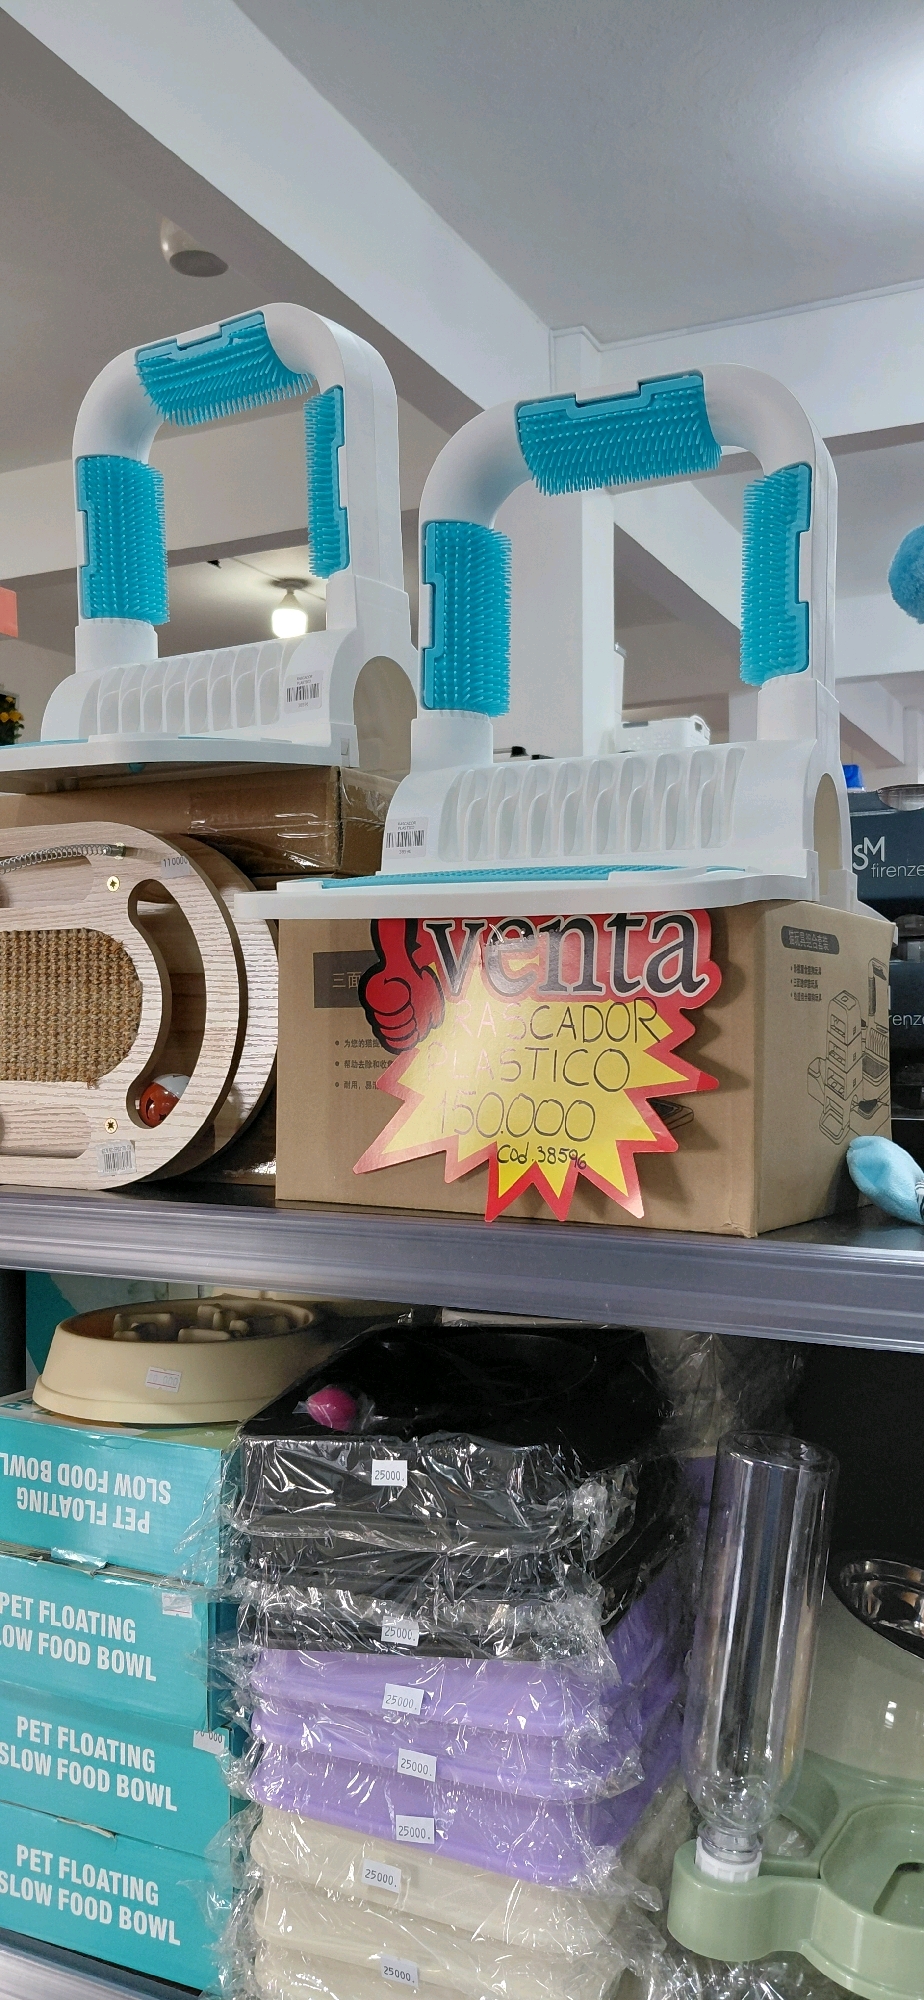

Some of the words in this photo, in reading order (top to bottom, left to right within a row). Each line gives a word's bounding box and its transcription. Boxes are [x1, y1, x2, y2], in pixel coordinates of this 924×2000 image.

[423, 912, 709, 997] venta
[452, 997, 661, 1043] RASCADOR
[427, 1041, 630, 1093] PLASTICO
[433, 1091, 596, 1142] 150.000
[0, 1453, 51, 1483] BOWL
[58, 1463, 108, 1493] FOOD
[114, 1473, 171, 1504] SLOW
[16, 1487, 107, 1526] FLOATING
[112, 1505, 150, 1534] PET
[0, 1592, 33, 1620] PET
[39, 1600, 136, 1643] FLOATING
[0, 1624, 33, 1651] OW
[38, 1632, 91, 1666] FOOD
[97, 1645, 156, 1682] BOWL
[17, 1716, 52, 1745] PET
[57, 1726, 155, 1773] FLOATING
[0, 1742, 51, 1777] SLOW
[57, 1758, 110, 1793] FOOD
[117, 1774, 178, 1811] BOWL
[16, 1844, 53, 1875] PET
[59, 1856, 159, 1906] FLOATING
[0, 1871, 52, 1906] SLOW
[58, 1888, 112, 1925] FOOD
[119, 1905, 181, 1946] BOWL
